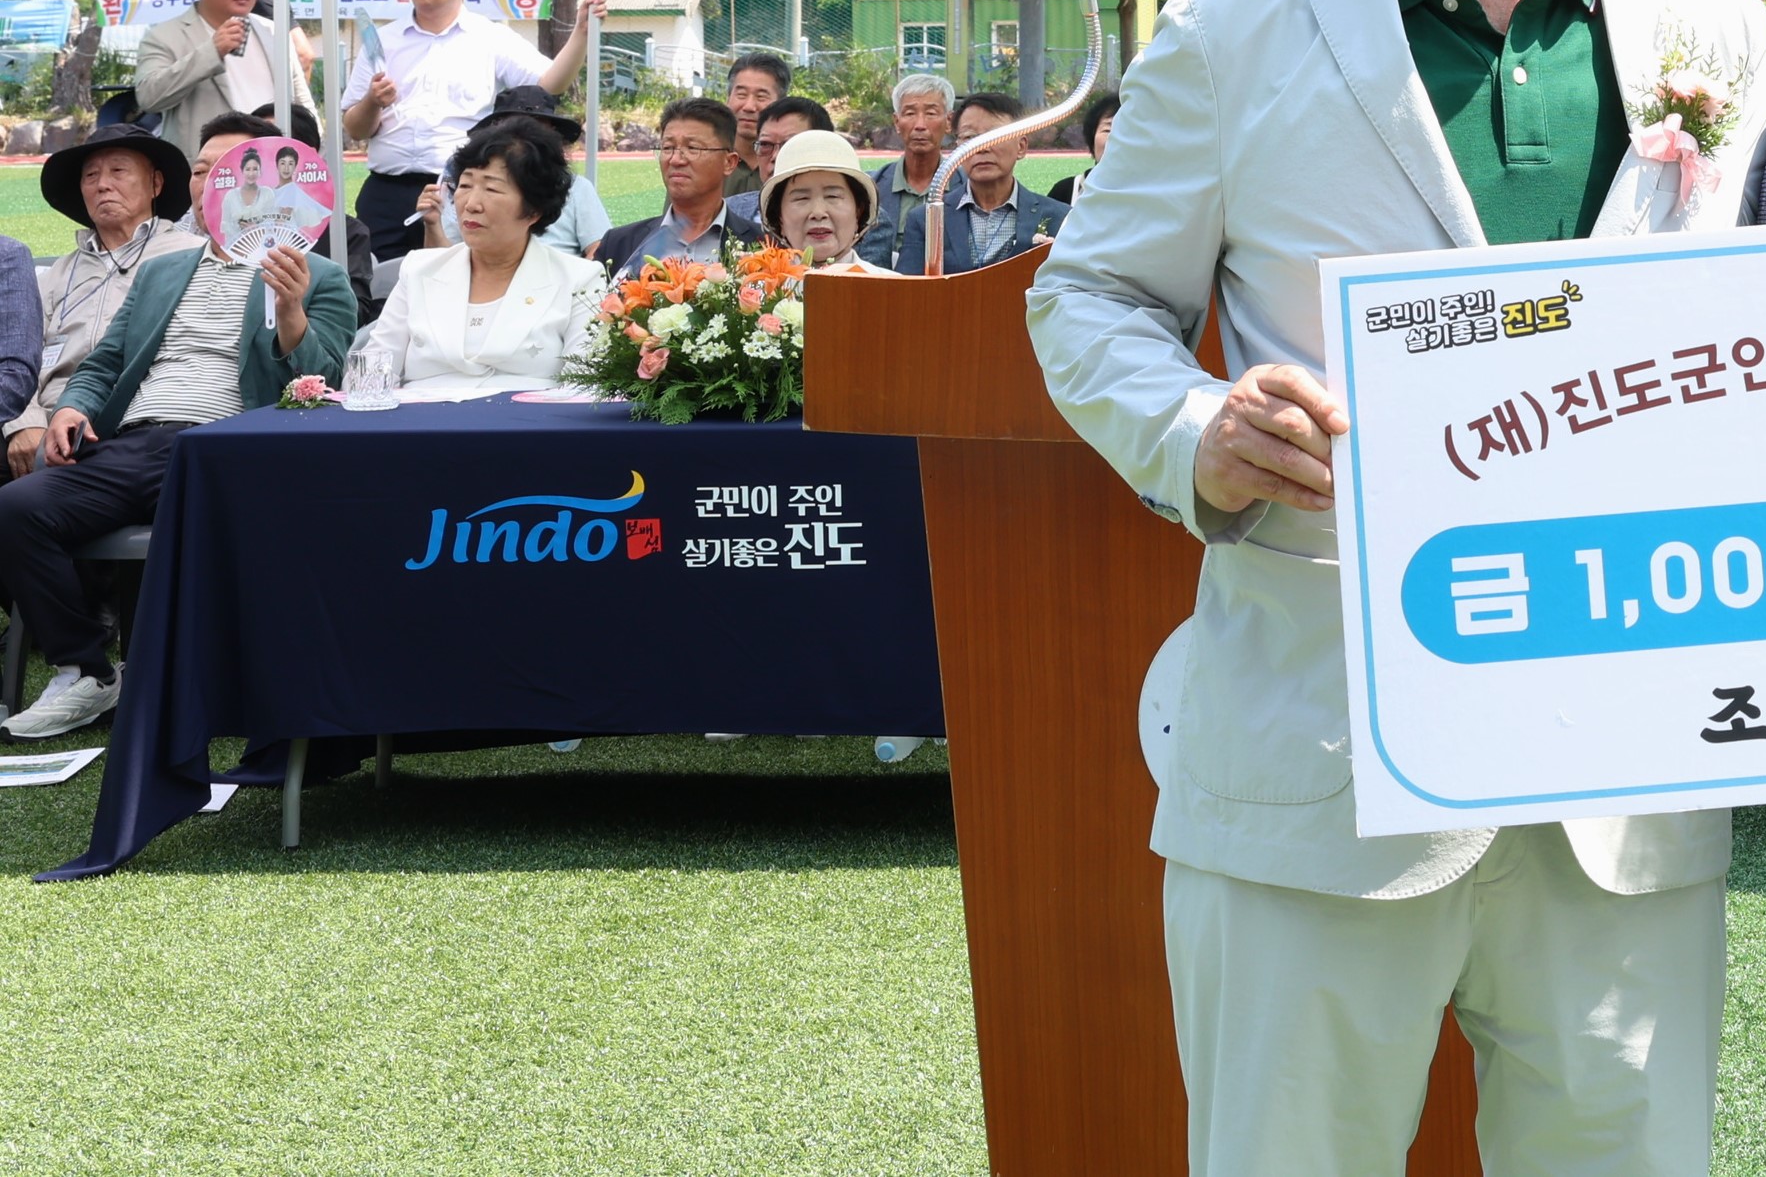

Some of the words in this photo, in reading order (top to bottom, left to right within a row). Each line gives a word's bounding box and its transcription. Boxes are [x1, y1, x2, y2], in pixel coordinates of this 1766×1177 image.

[1366, 298, 1435, 333] 군민이
[1440, 289, 1496, 320] 주인!
[1405, 317, 1497, 354] 살기좋은
[1501, 294, 1571, 338] 진도
[694, 485, 778, 517] 군민이
[788, 483, 843, 516] 주인
[405, 505, 619, 570] Jindo
[682, 537, 779, 568] 살기좋은
[783, 522, 867, 569] 진도
[1450, 552, 1529, 636] 금
